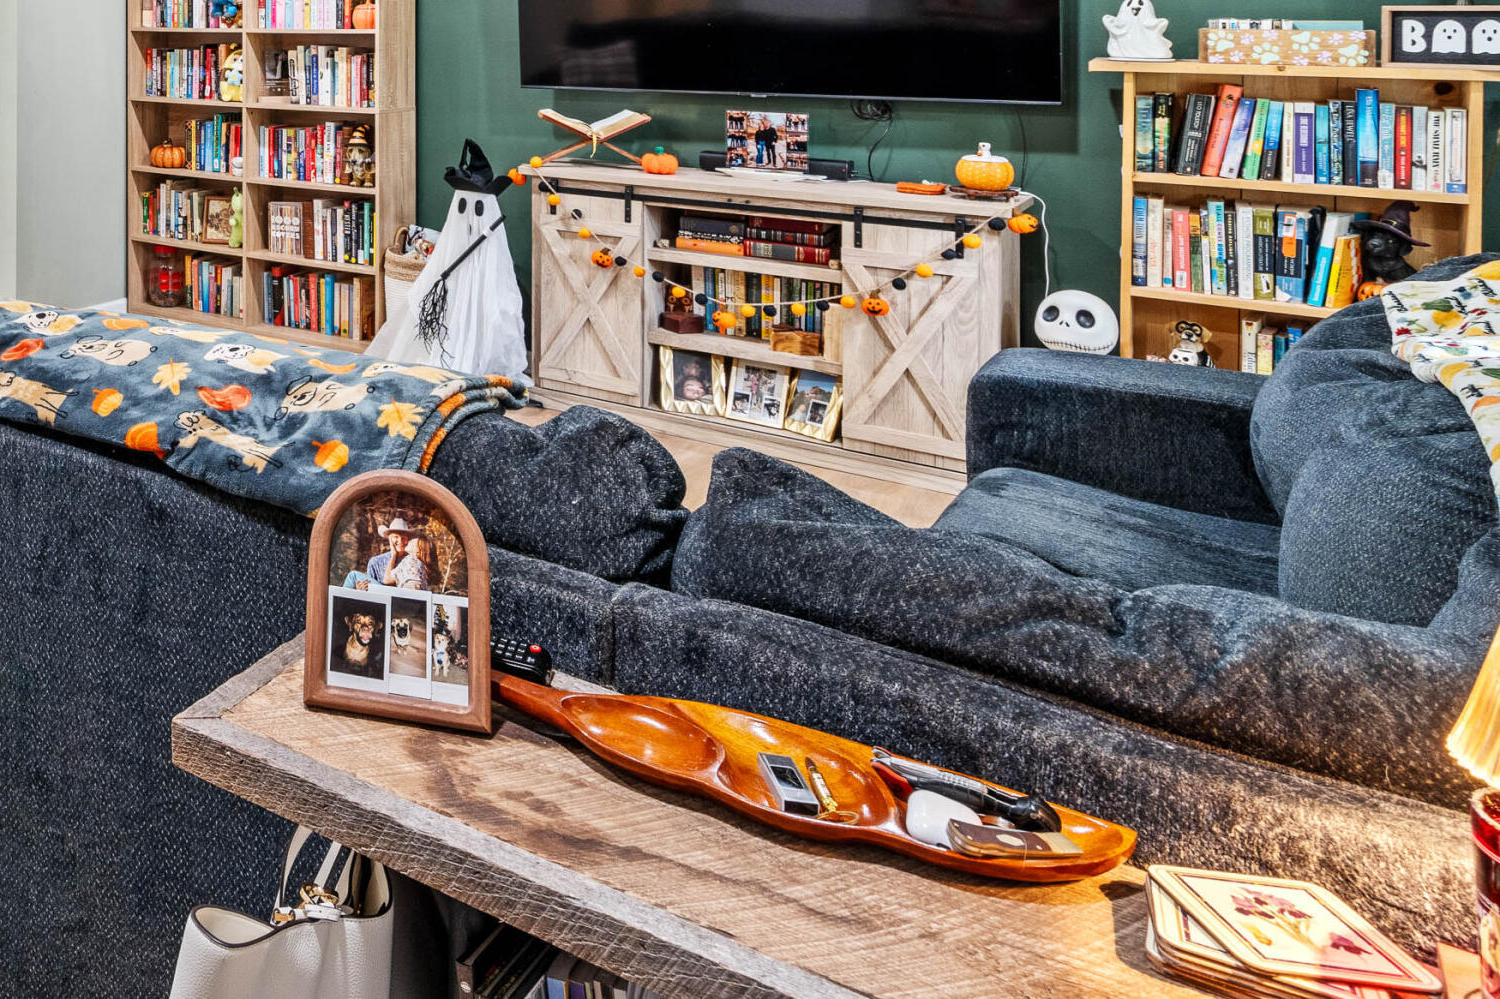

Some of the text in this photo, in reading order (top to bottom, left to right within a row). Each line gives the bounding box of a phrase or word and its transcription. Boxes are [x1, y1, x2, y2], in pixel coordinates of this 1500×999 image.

[1345, 105, 1356, 142] LISA JEWELL
[1432, 130, 1441, 150] SMALL
